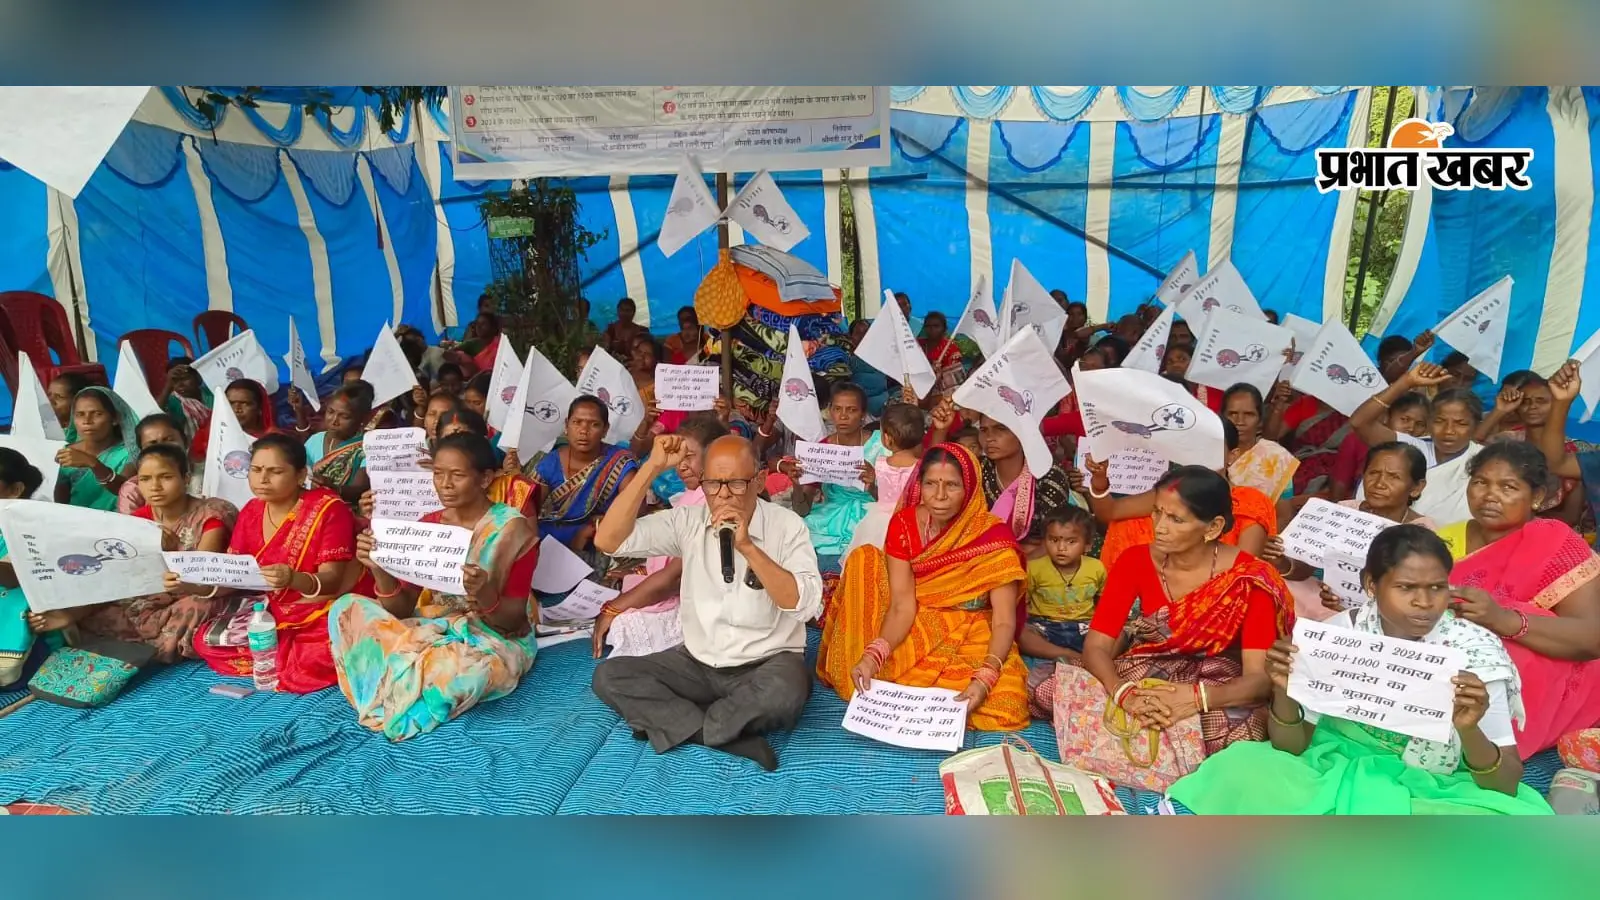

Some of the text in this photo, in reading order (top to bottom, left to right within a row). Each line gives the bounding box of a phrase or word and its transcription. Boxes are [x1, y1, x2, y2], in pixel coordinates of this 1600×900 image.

[1303, 628, 1327, 642] वर्ष
[1331, 634, 1363, 650] 2020
[1369, 640, 1385, 654] से
[1385, 661, 1435, 683] बकाया
[1386, 679, 1409, 693] का
[1341, 687, 1397, 709] भुगतान
[1403, 701, 1447, 720] करना
